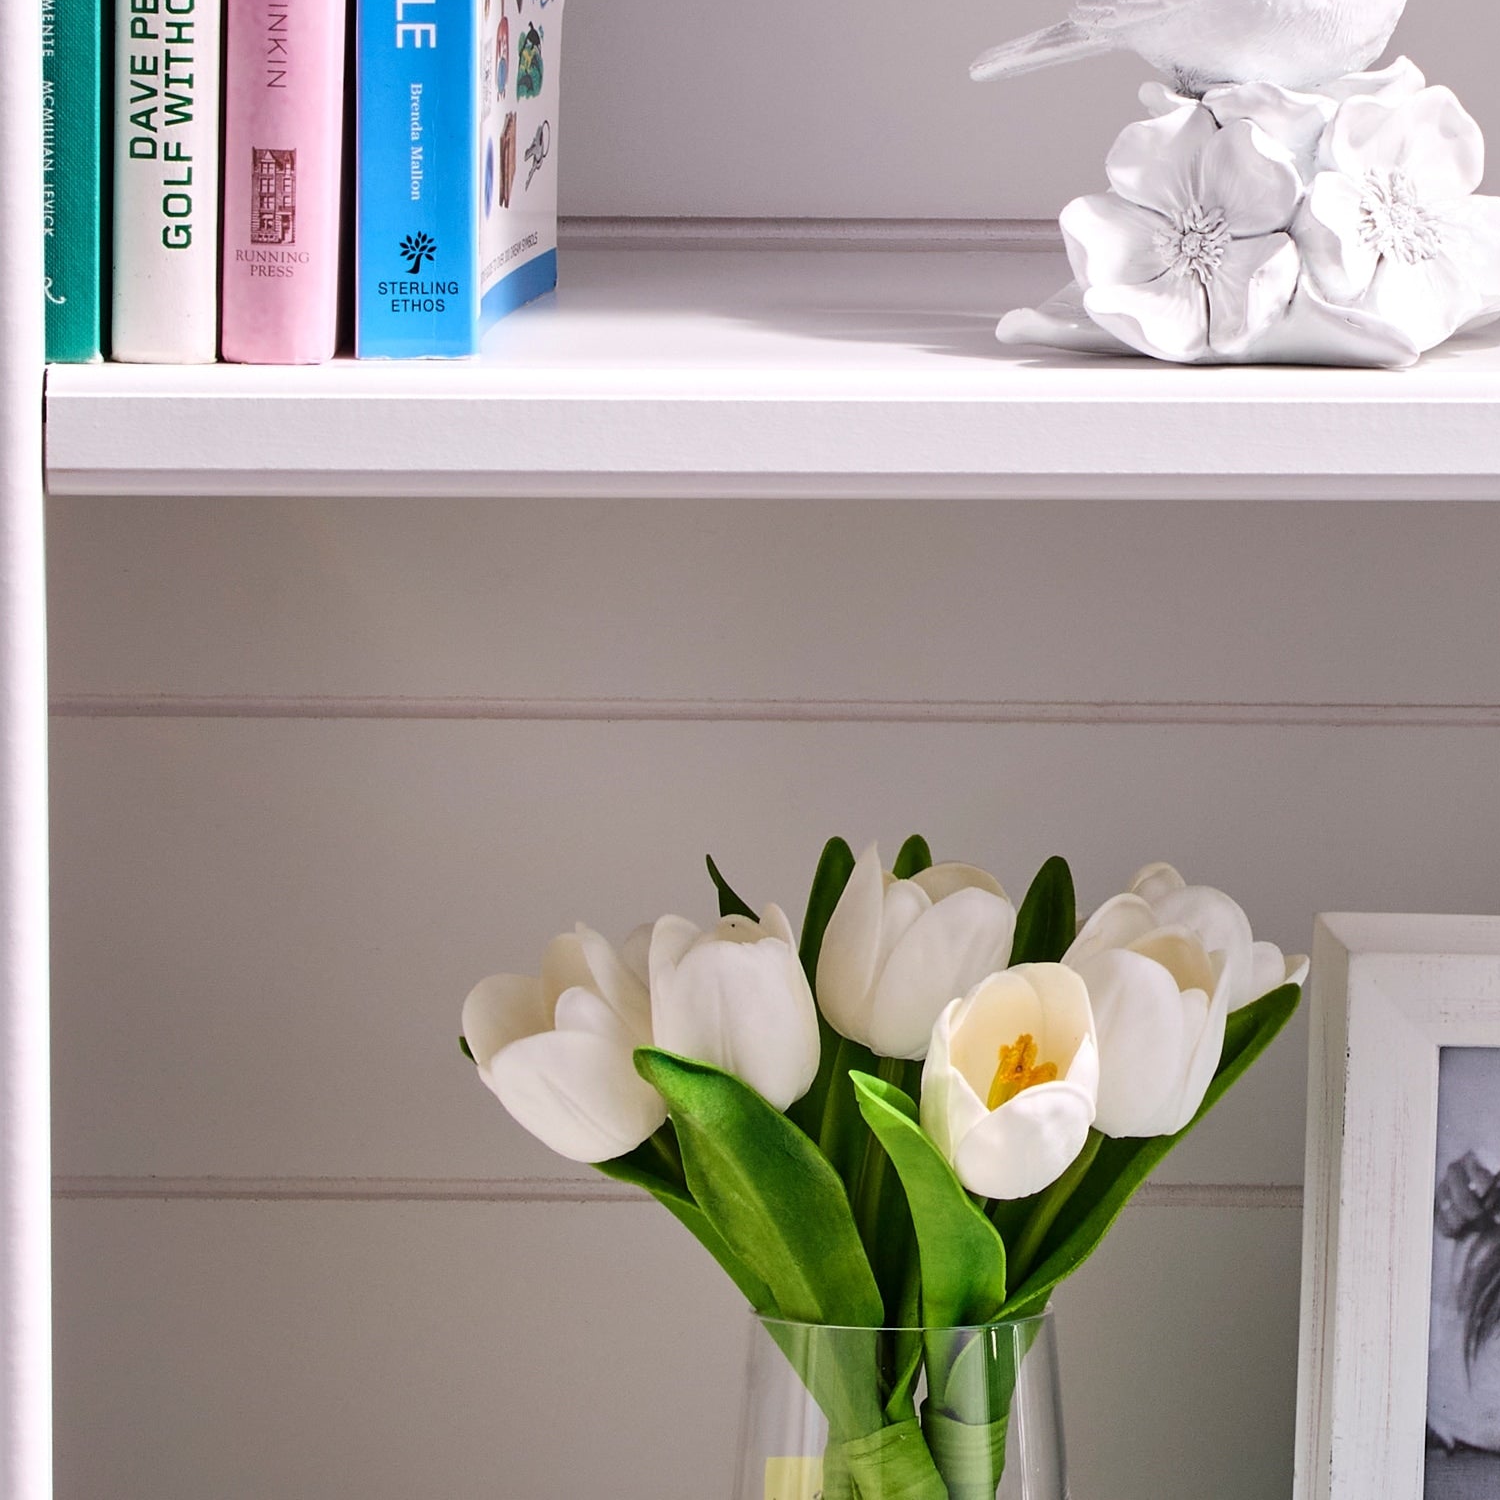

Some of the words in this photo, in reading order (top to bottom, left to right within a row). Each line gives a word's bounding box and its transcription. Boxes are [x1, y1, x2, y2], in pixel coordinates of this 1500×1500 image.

[130, 55, 158, 159] DAVE
[410, 83, 423, 141] Brenda
[410, 146, 423, 200] Mallon
[162, 141, 193, 249] GOLF
[235, 250, 309, 264] RUNNING
[250, 265, 294, 278] PRESS
[378, 281, 459, 295] STERLING
[391, 299, 446, 313] ETHOS
